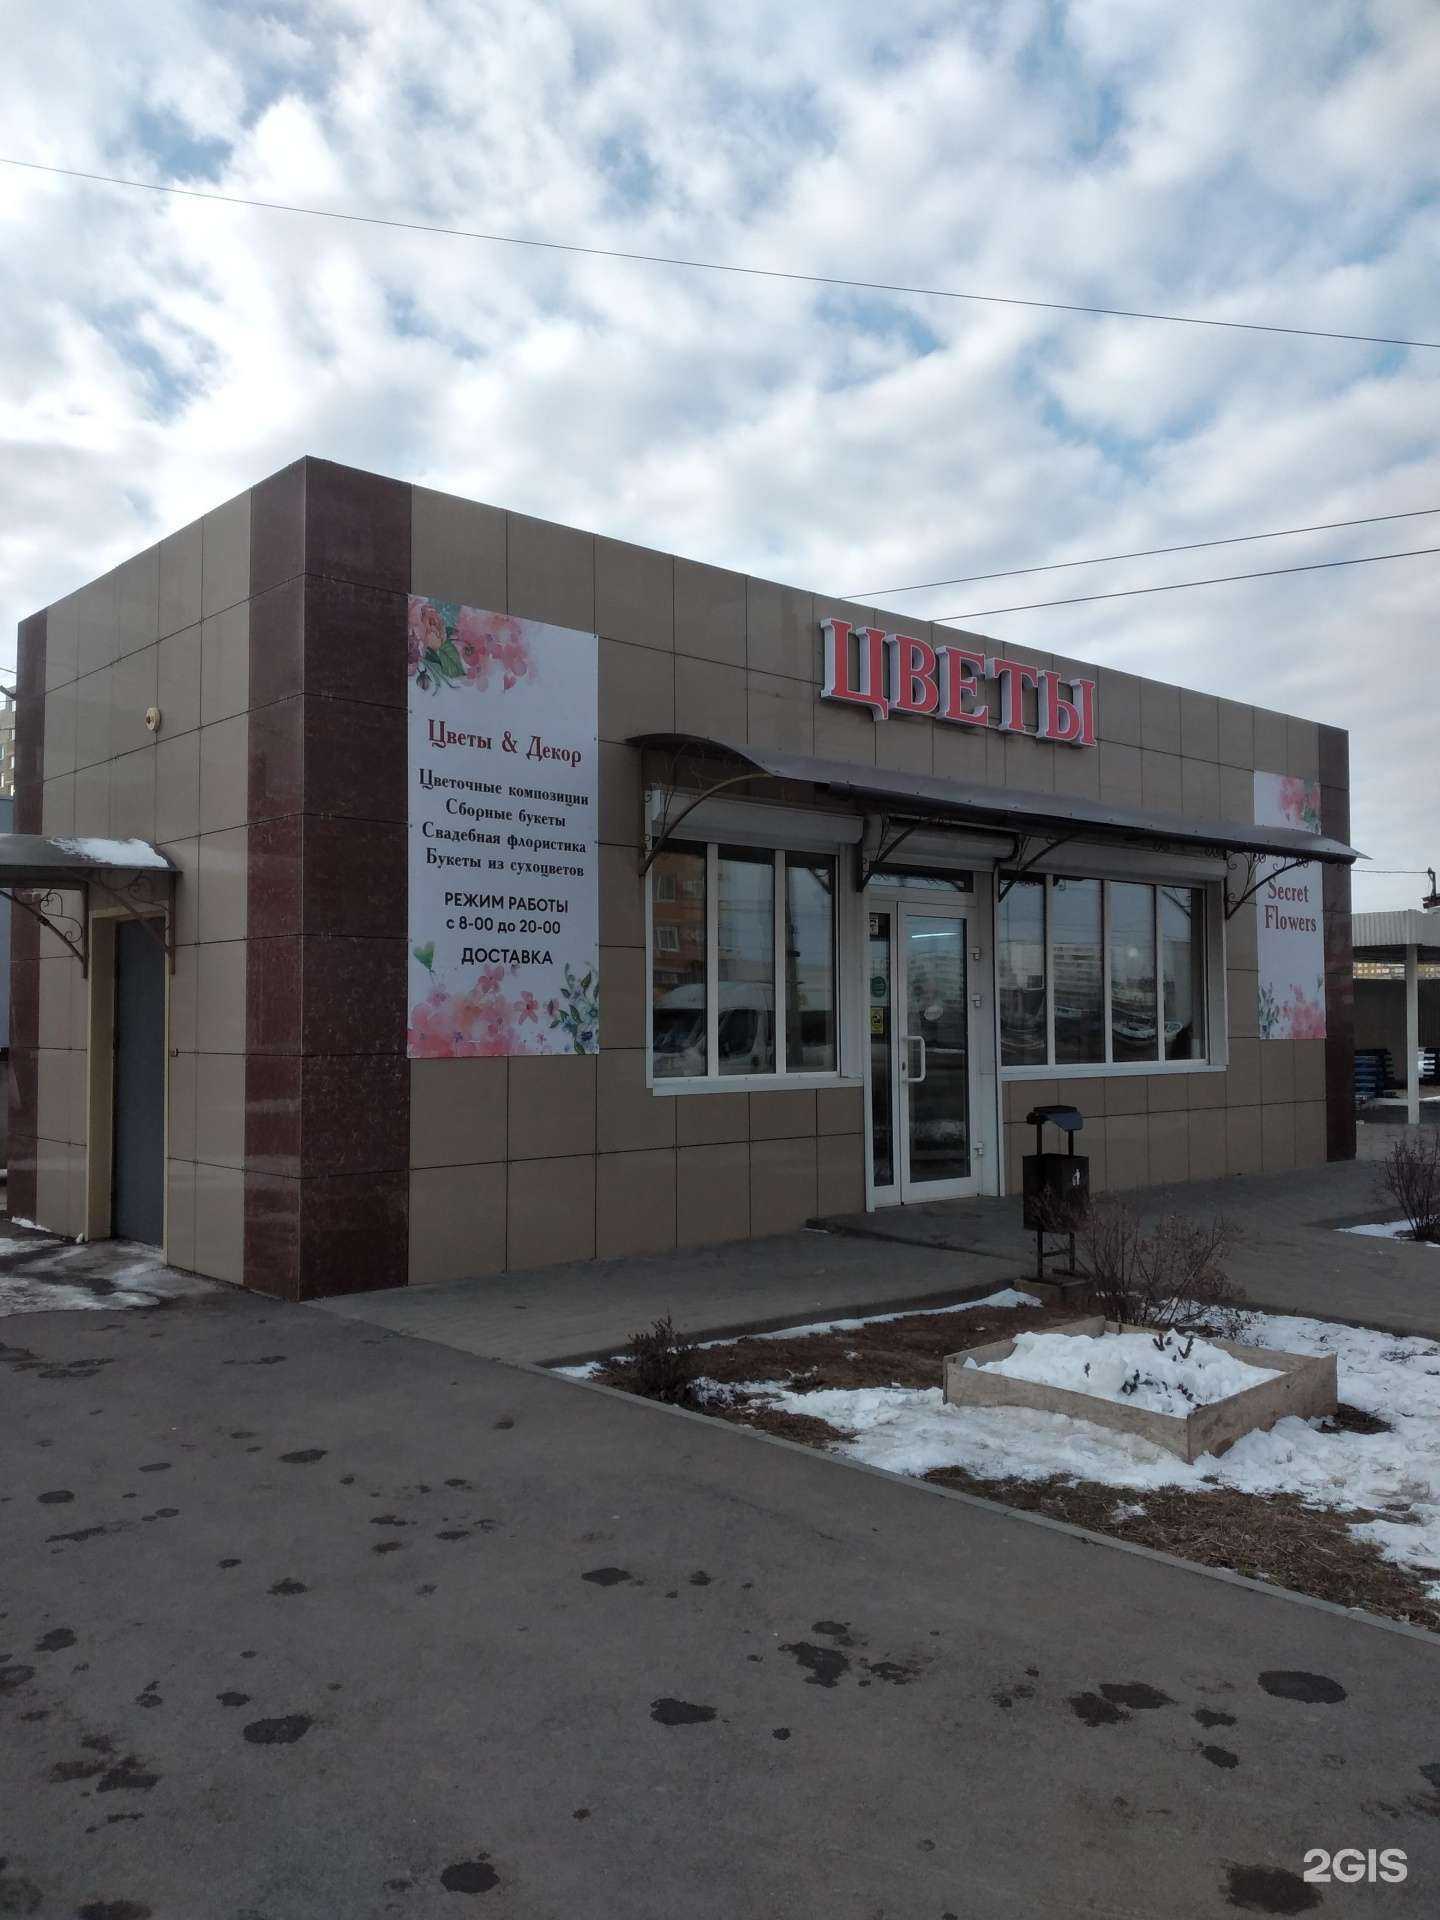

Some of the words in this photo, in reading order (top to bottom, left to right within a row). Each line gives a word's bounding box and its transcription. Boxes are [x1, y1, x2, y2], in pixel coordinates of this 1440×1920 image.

[820, 616, 1097, 747] ЦВЕТЫ
[427, 719, 492, 750] Цветы
[501, 730, 519, 753] &
[526, 735, 583, 768] Декор
[419, 768, 503, 794] Цветочные
[508, 785, 589, 806] композиции
[446, 797, 513, 821] Сборные
[518, 809, 566, 827] букеты
[422, 821, 501, 845] Свадебная
[507, 834, 587, 853] флористика
[426, 847, 481, 868] Букеты
[487, 859, 505, 870] из
[510, 860, 585, 877] сухоцветов
[444, 892, 504, 909] РЕЖИМ
[508, 896, 568, 913] РАБОТЫ
[1267, 876, 1309, 903] Secret
[446, 918, 455, 930] с
[458, 916, 493, 931] 8-00
[497, 922, 516, 934] до
[519, 919, 561, 934] 20-00
[1264, 904, 1317, 932] Flowers
[461, 947, 553, 965] ДОСТАВКА
